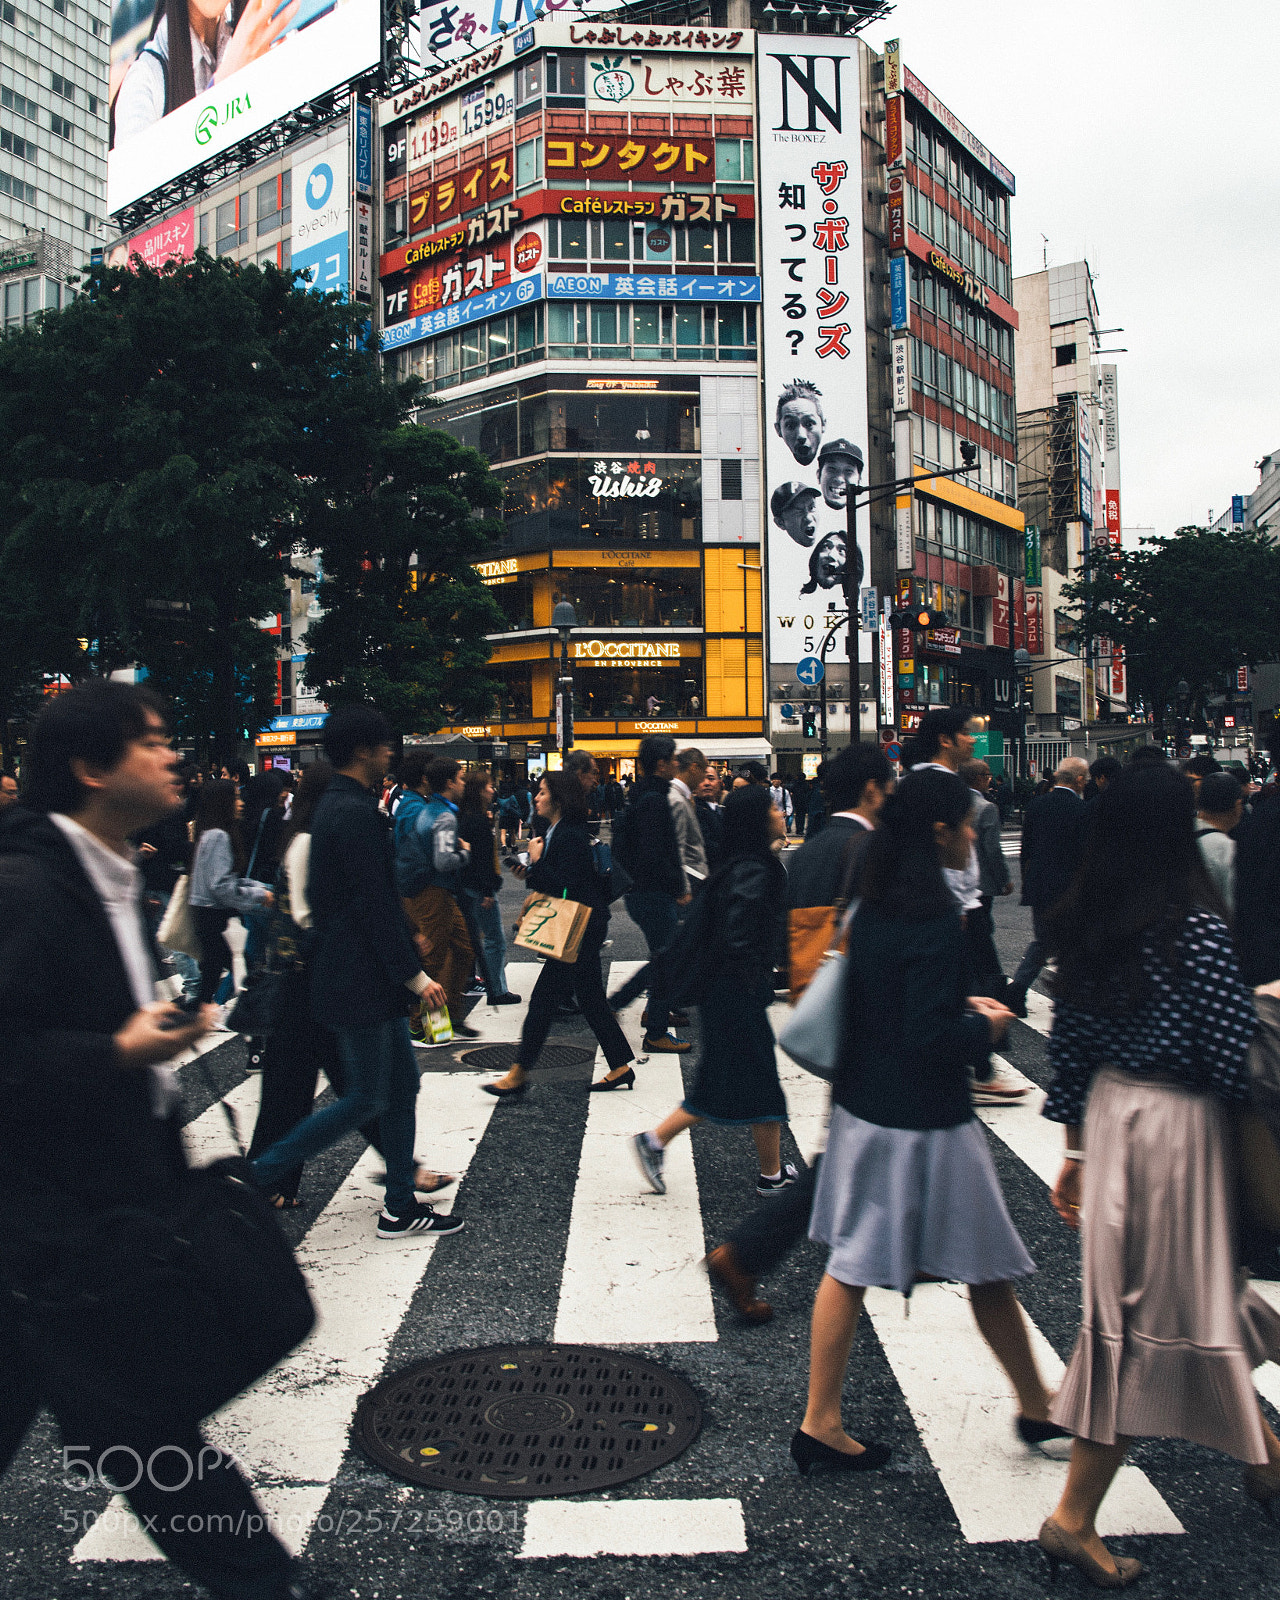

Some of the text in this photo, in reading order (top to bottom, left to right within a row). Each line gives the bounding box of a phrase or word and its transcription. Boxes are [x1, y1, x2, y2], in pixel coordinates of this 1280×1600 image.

[570, 26, 743, 50] しゃぶしゃぶバイキング
[394, 45, 503, 115] しゃぶしゃぶバイキング
[645, 66, 746, 98] しゃぶ葉
[388, 138, 406, 163] 9F
[772, 133, 827, 144] The BONEZ
[547, 140, 709, 172] コンタクト
[410, 156, 513, 225] プライス
[661, 192, 737, 222] ガスト
[298, 207, 341, 239] eyecity
[468, 204, 520, 247] ガスト
[890, 206, 902, 243] ガスト
[144, 222, 190, 259] 品川スキン
[811, 160, 851, 360] ザ・ボーンズ
[442, 253, 506, 306] ガスト
[554, 275, 757, 297] AEON 英会話イーオン
[383, 281, 534, 346] AEON 英会話イーオン 6F
[386, 289, 409, 316] 7F
[593, 460, 657, 475] 渋谷焼肉
[587, 474, 663, 498] Ushi8
[1026, 527, 1034, 549] レイク
[602, 551, 652, 559] L'OCCITANE
[1028, 617, 1037, 642] アコム
[575, 640, 680, 658] L'OCCITANE
[634, 722, 679, 730] L'OCCITANE
